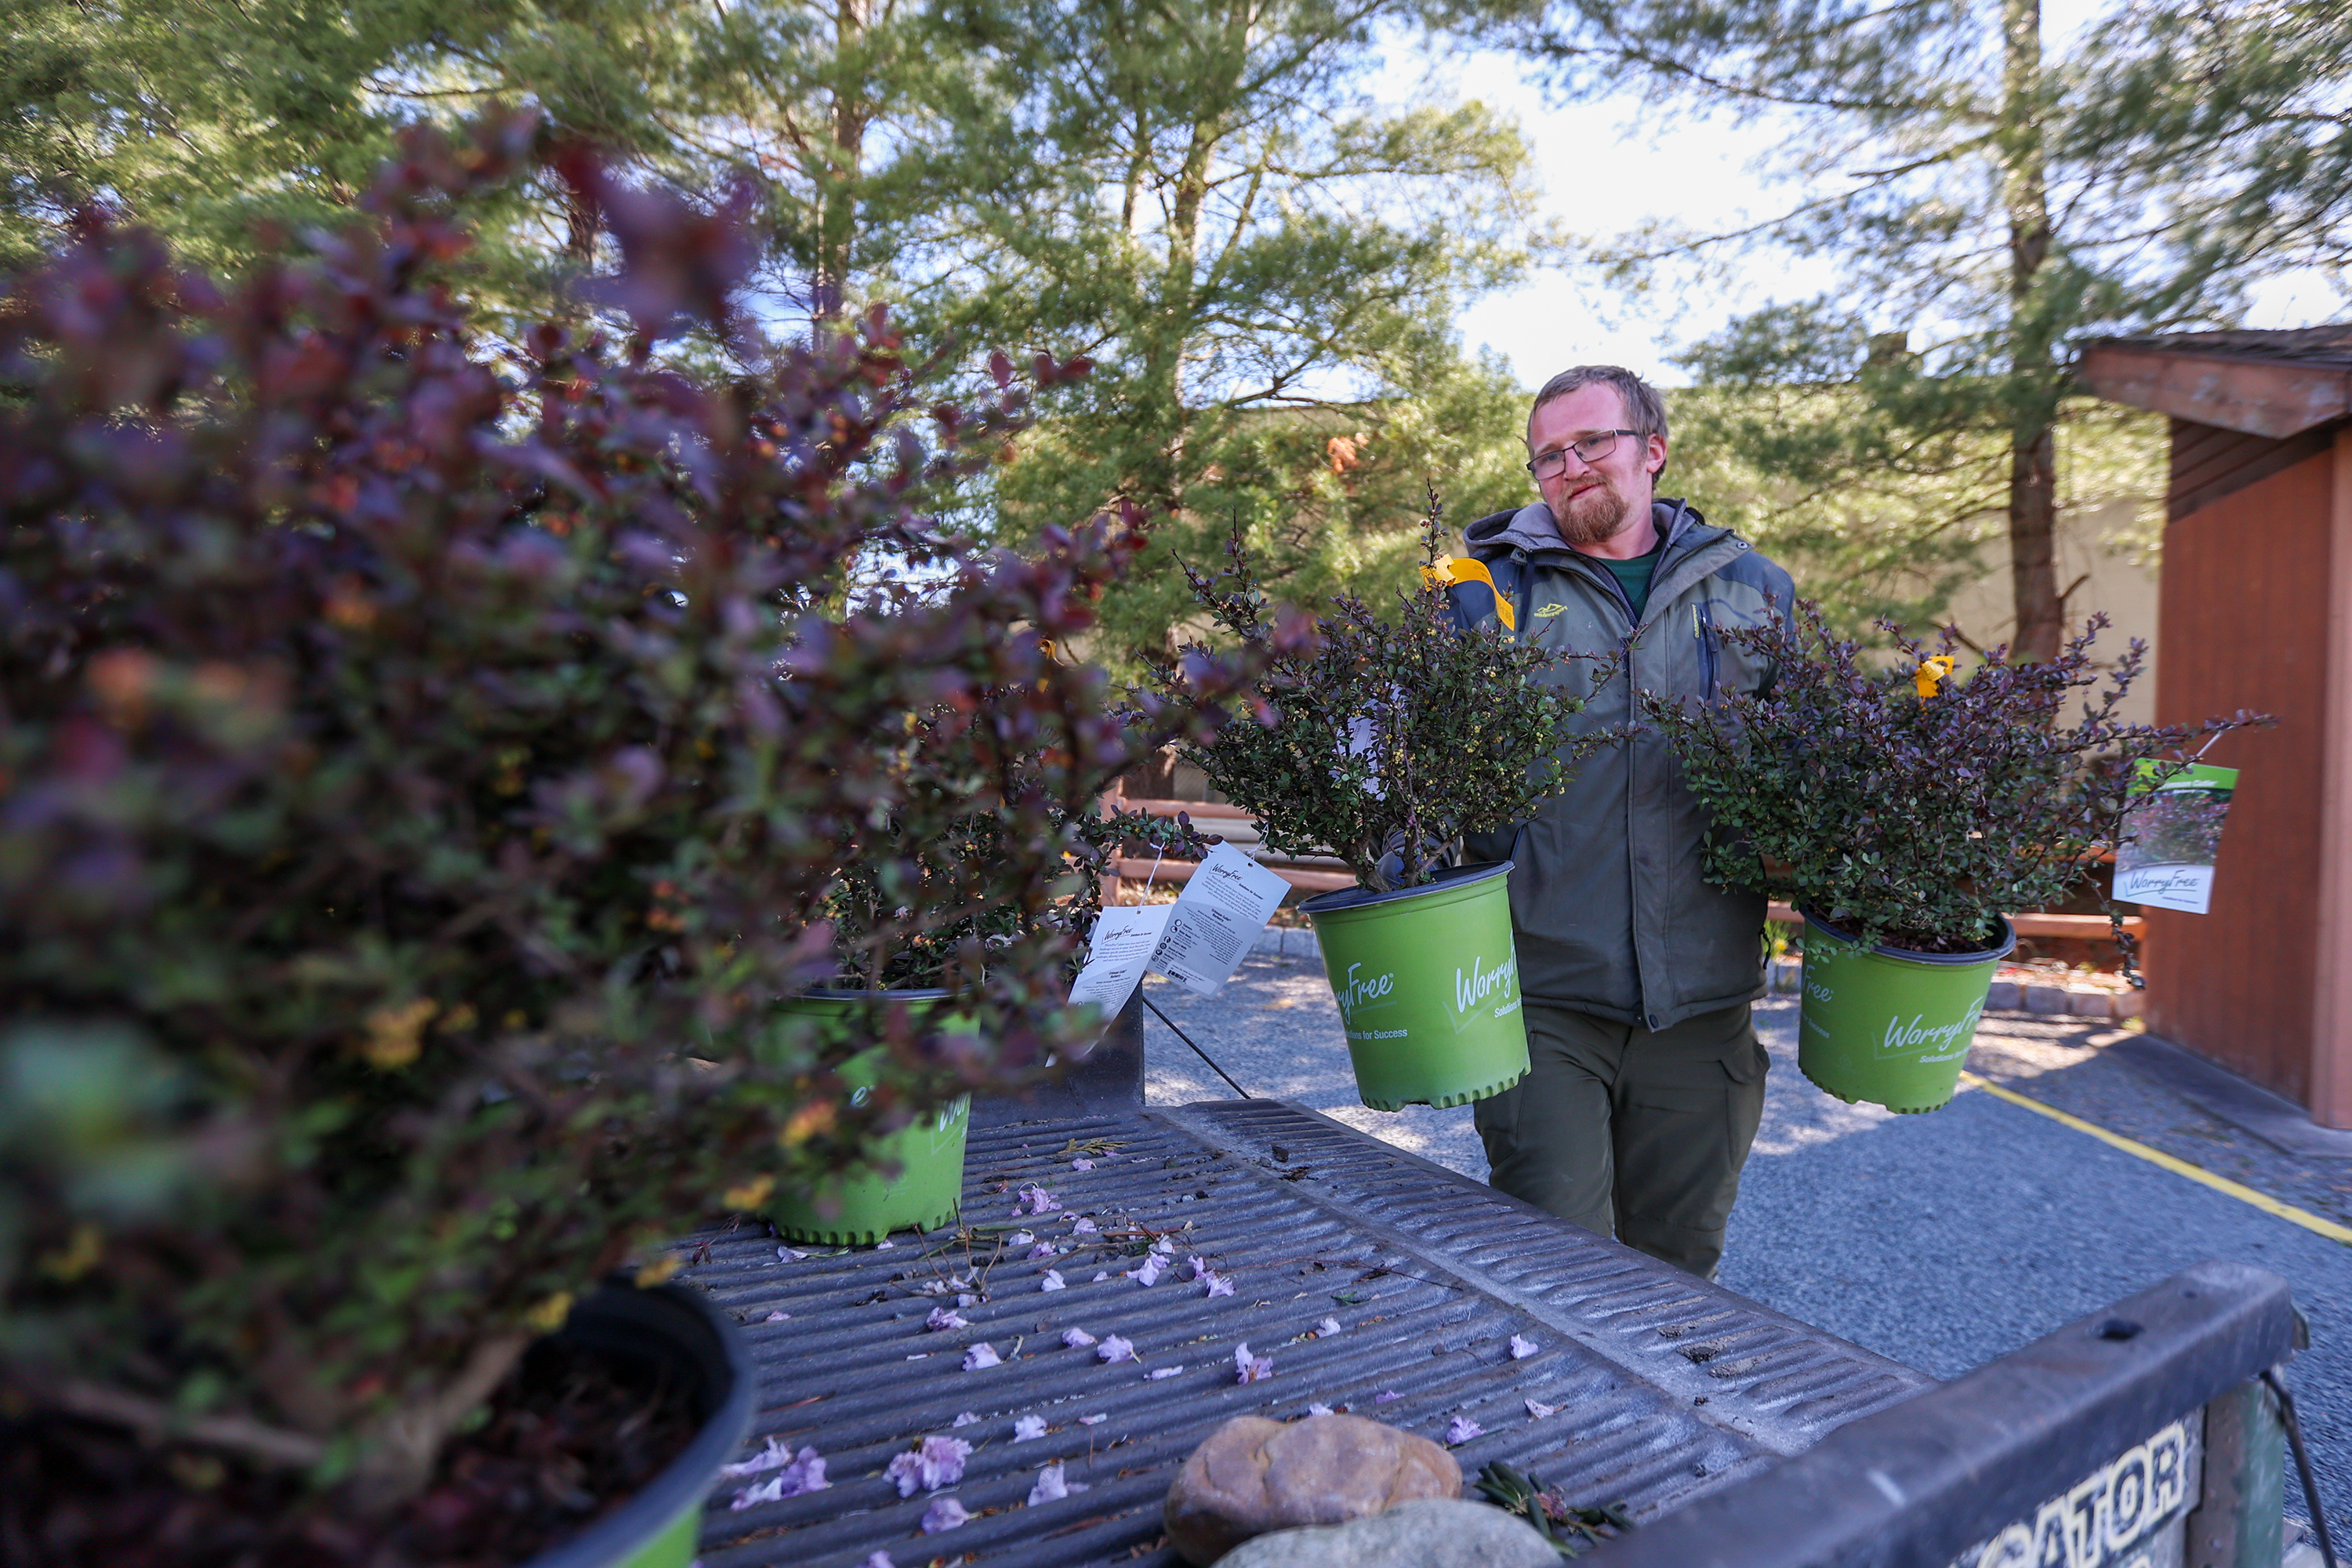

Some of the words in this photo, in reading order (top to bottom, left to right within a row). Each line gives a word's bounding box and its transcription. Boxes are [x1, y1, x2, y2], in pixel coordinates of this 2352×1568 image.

[2130, 869, 2198, 895] WorryFree
[1494, 999, 1518, 1018] Solutions
[1362, 1031, 1373, 1040] for
[1374, 1029, 1408, 1040] Success
[1919, 1054, 1955, 1063] Solutions
